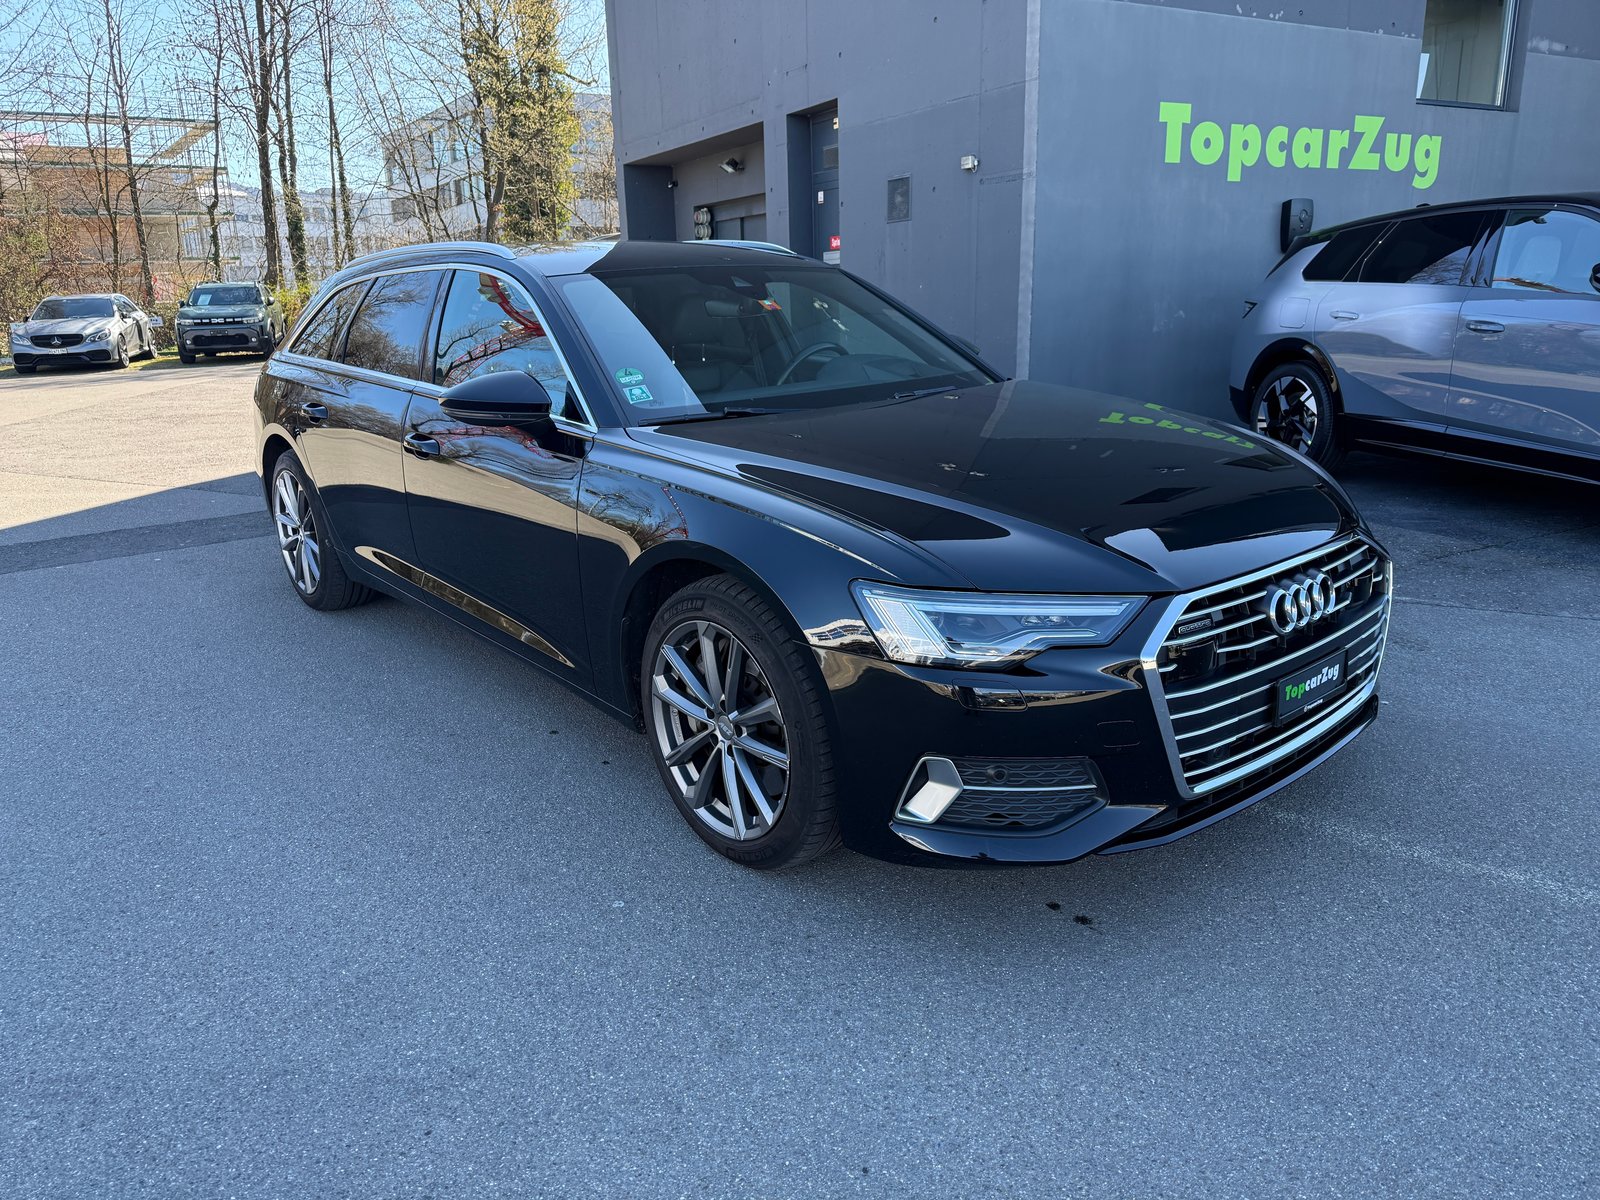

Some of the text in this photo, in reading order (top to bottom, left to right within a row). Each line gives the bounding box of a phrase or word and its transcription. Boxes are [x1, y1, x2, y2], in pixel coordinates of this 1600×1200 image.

[1159, 101, 1442, 189] TopcarZug
[664, 599, 704, 620] MICHELIN
[1285, 664, 1340, 700] TopcarZug
